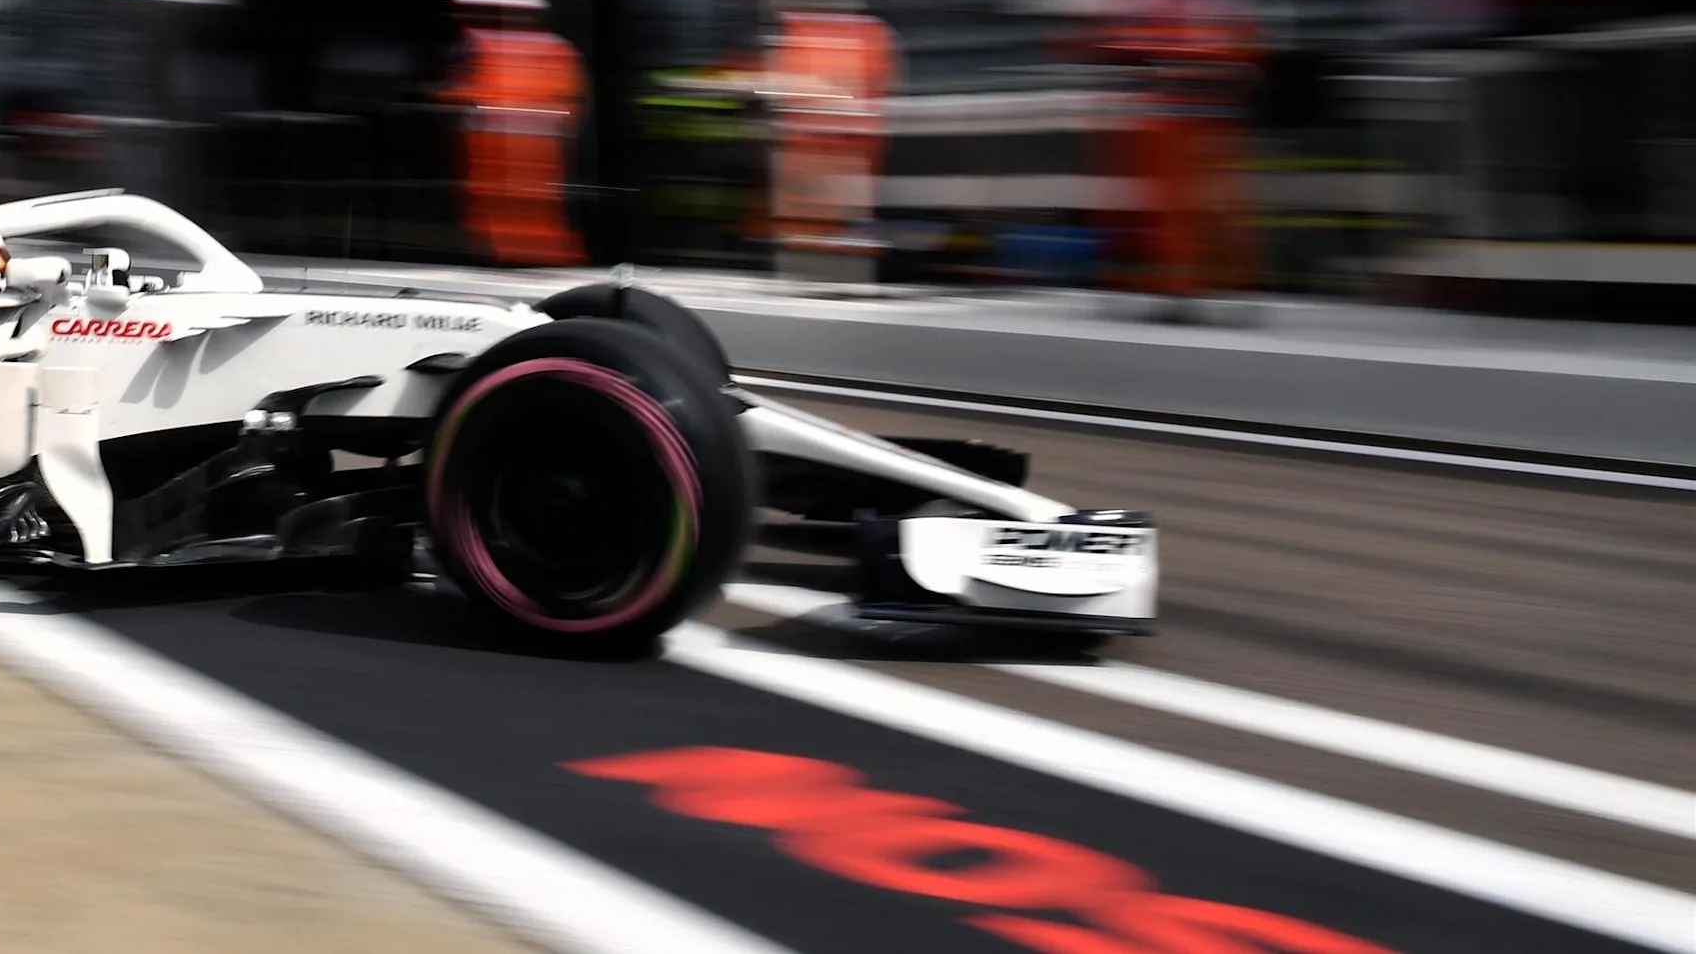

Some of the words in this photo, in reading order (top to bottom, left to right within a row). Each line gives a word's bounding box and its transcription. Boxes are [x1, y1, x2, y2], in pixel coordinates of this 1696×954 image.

[51, 318, 173, 339] CARRERA
[305, 309, 407, 330] RICHARD
[412, 313, 483, 333] MILLE
